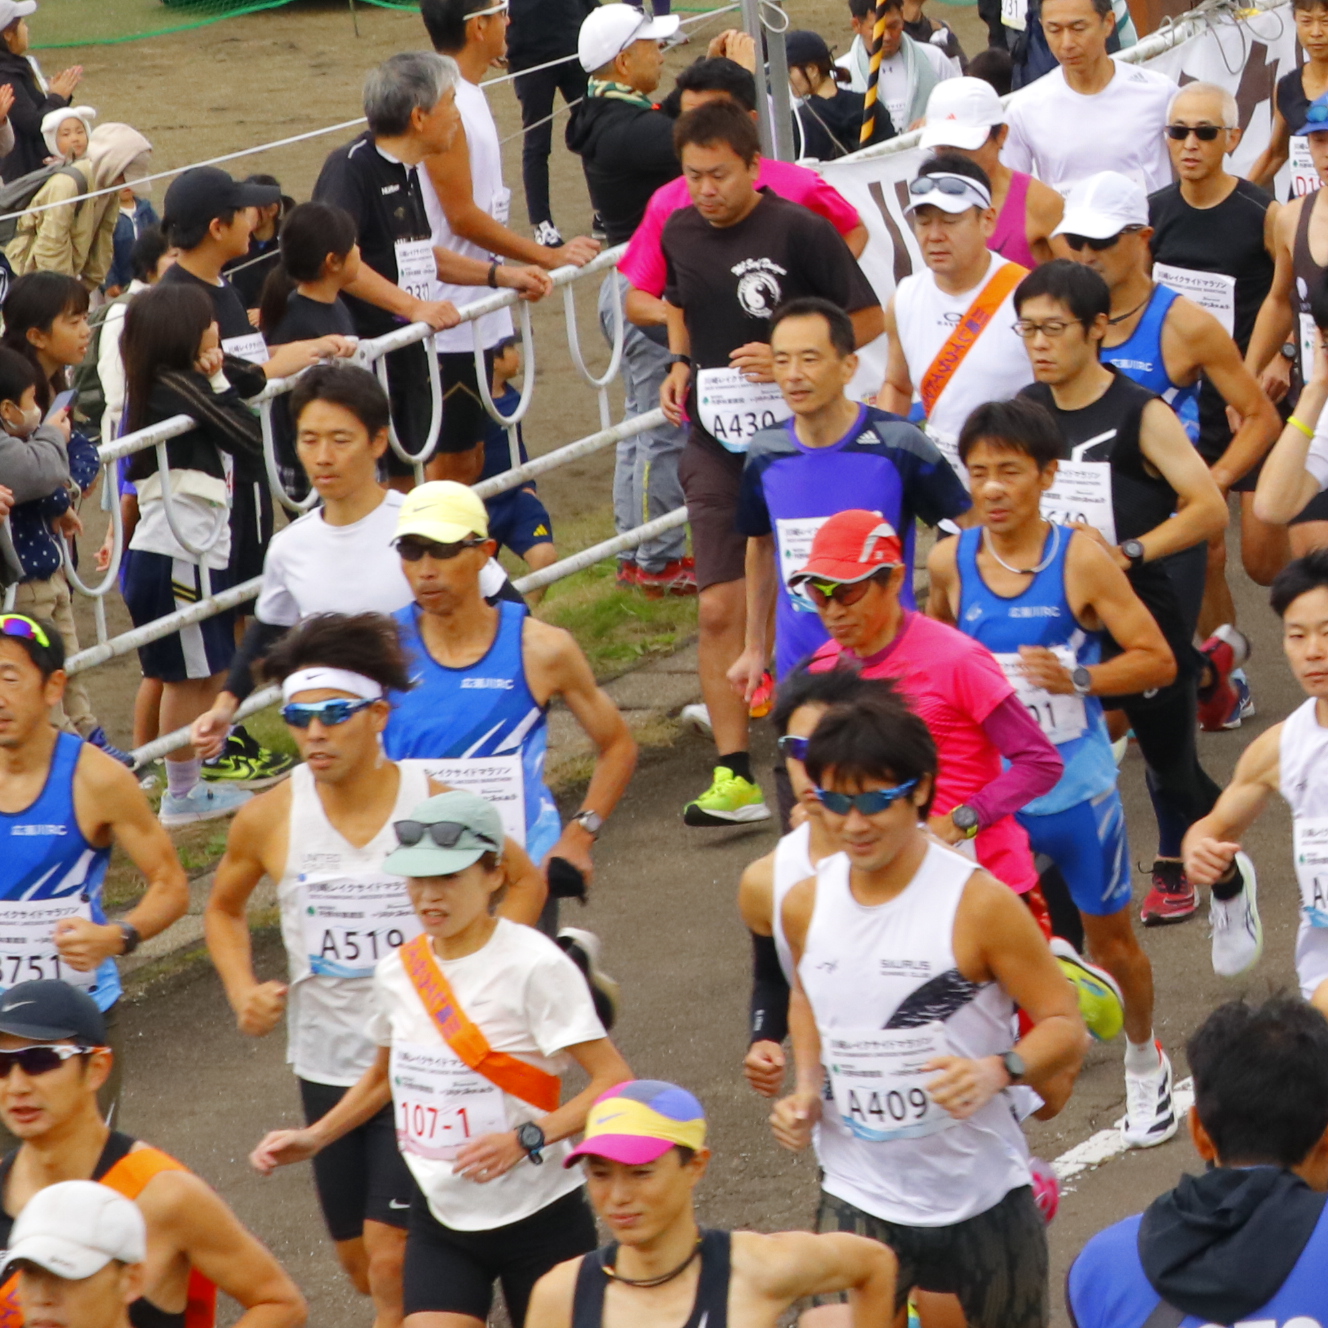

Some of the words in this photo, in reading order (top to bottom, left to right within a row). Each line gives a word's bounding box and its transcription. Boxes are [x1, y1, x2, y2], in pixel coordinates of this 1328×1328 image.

[320, 929, 405, 960] A519
[0, 955, 63, 984] 751
[401, 1102, 471, 1138] 107-1
[848, 1088, 927, 1122] A409
